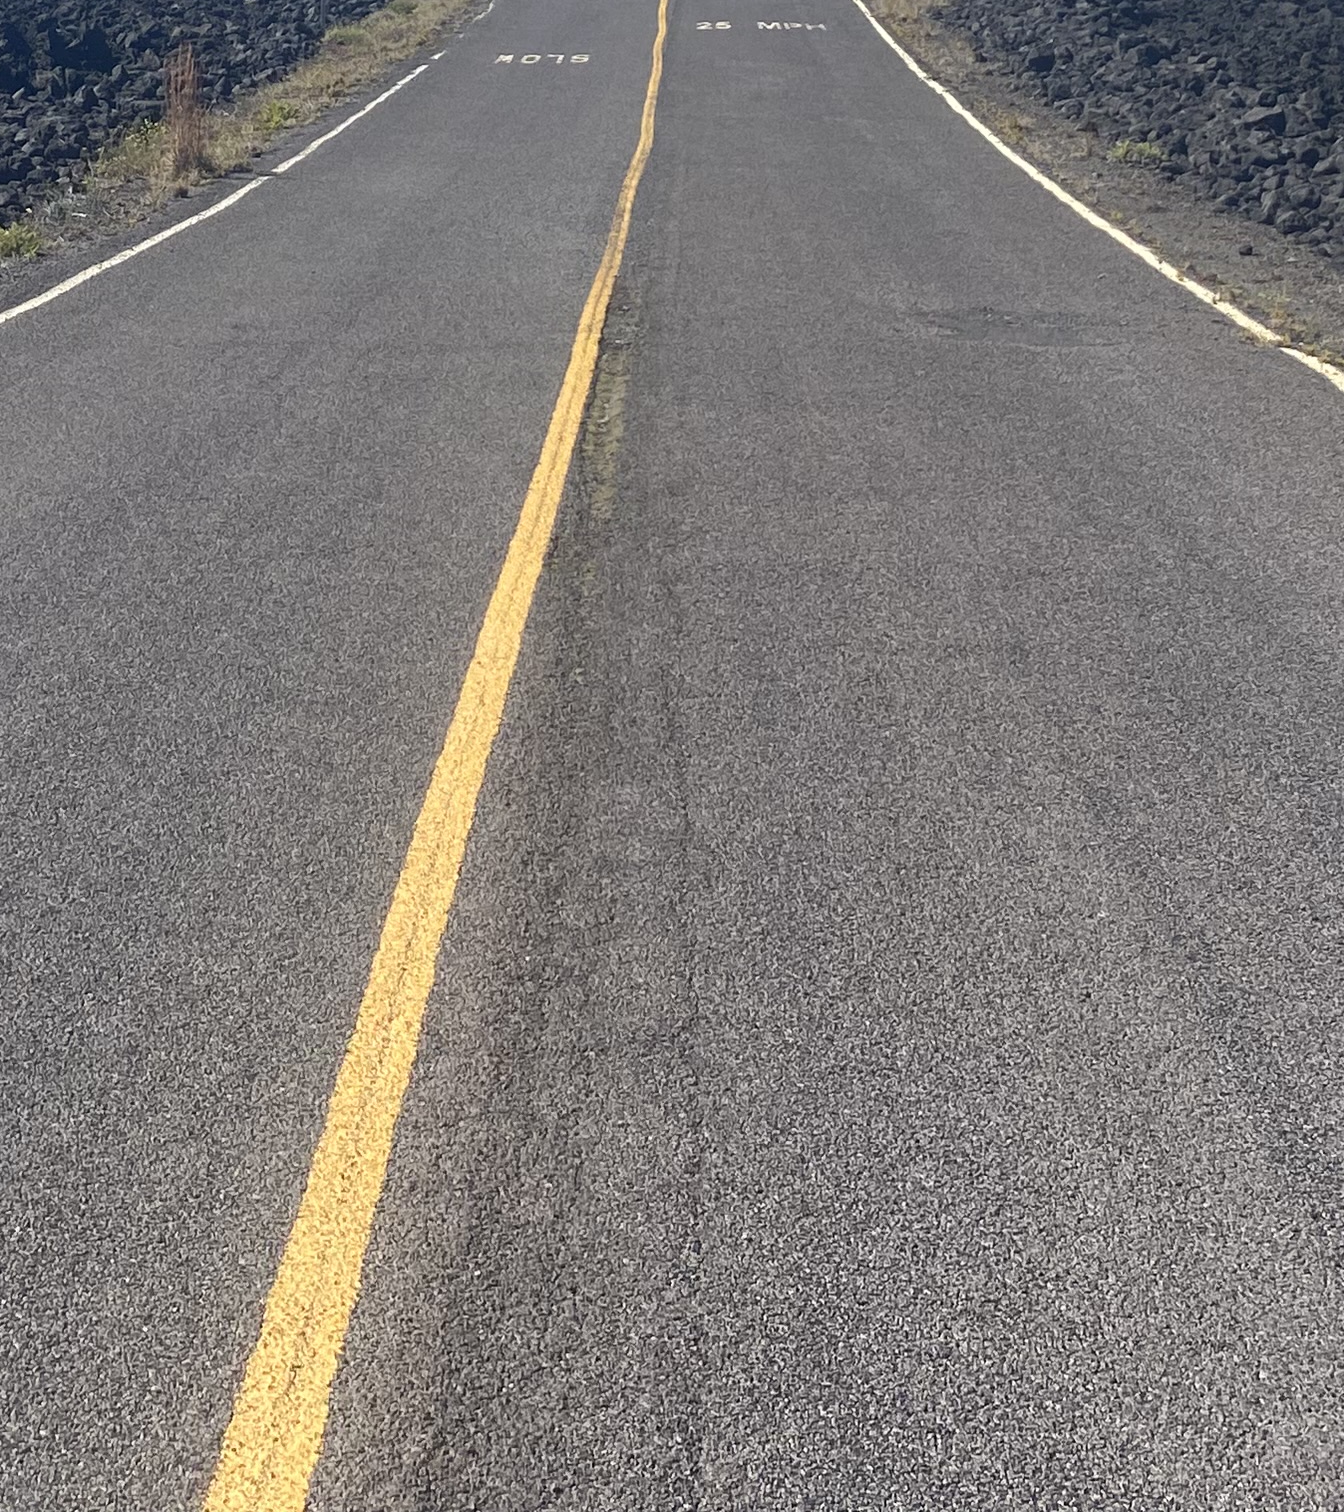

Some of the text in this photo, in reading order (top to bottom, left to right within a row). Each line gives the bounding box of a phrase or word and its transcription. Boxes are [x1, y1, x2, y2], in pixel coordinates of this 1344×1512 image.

[695, 21, 827, 31] 25 MPH
[493, 53, 591, 65] SLOW
